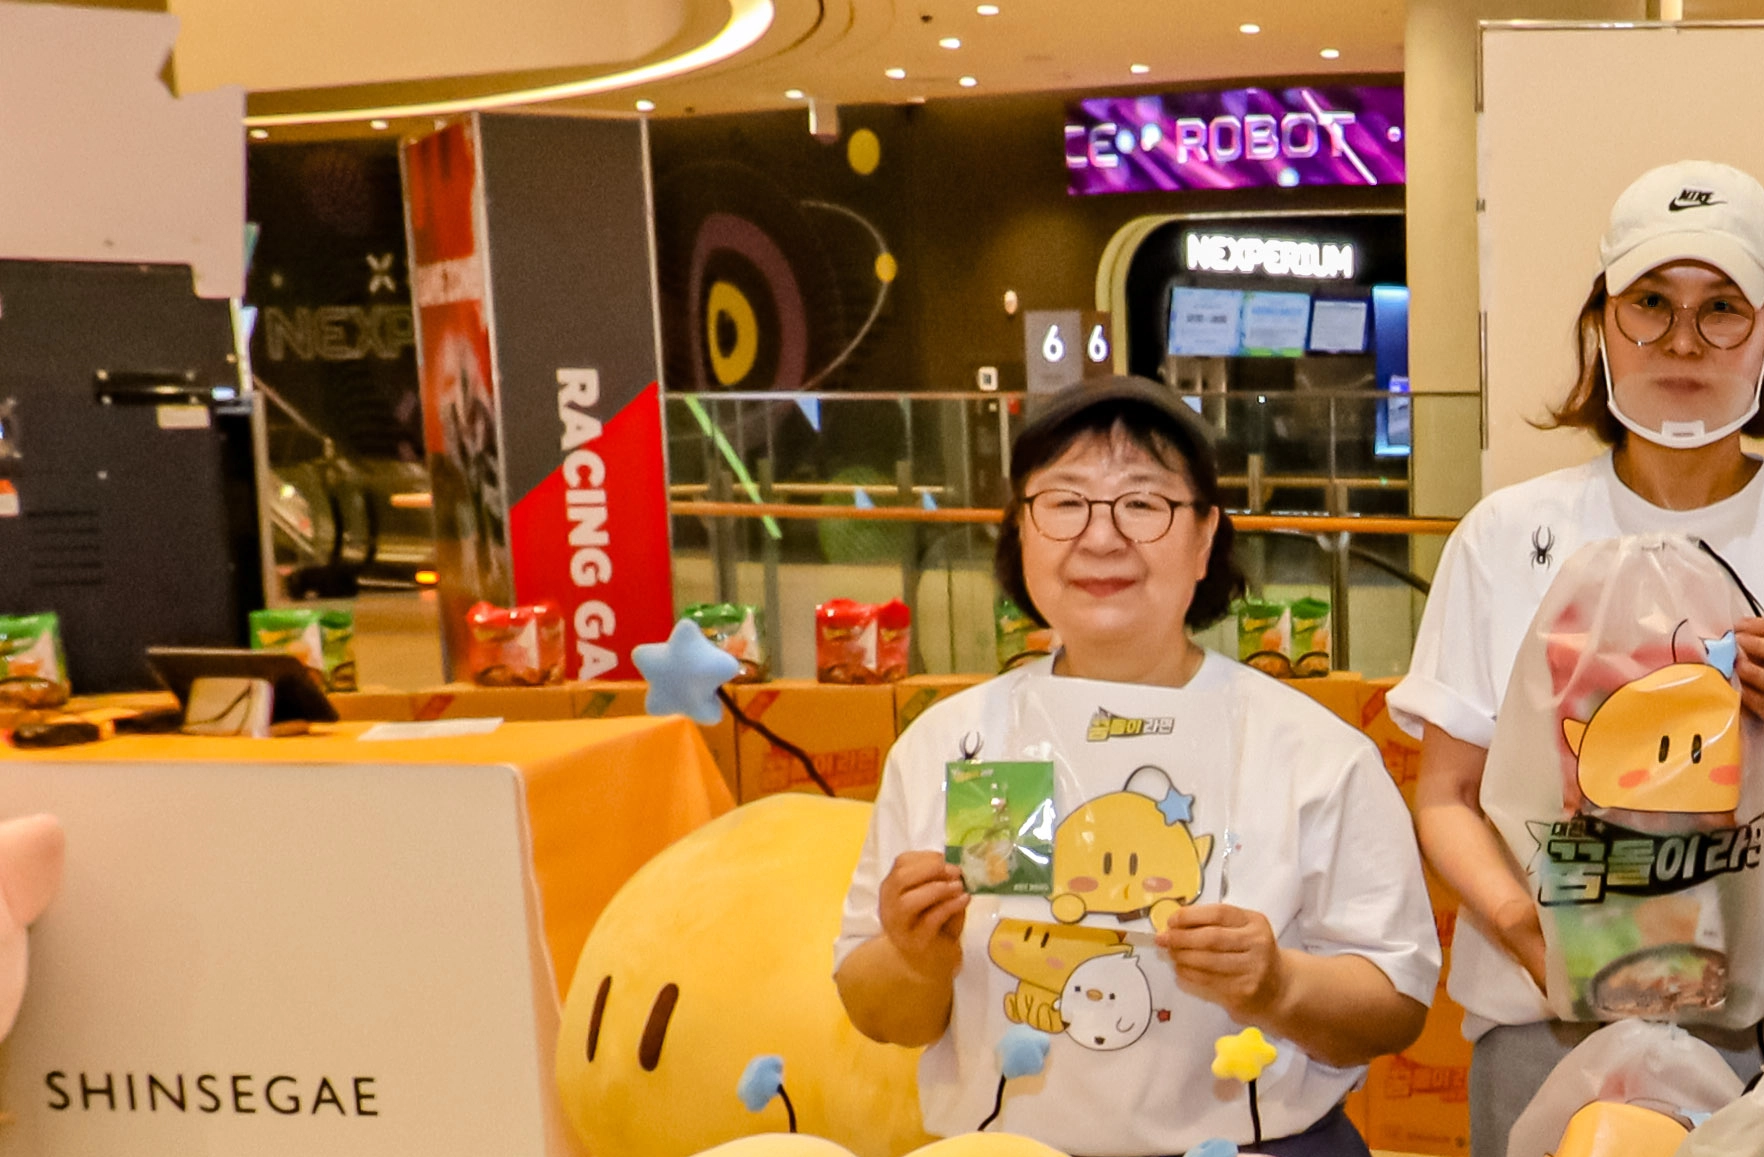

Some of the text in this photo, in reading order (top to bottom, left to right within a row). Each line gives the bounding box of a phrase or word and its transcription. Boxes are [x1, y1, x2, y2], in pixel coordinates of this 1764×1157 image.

[1176, 111, 1356, 164] ROBOT
[1186, 233, 1354, 278] NEXPERIUM
[1042, 324, 1065, 362] 6
[1087, 324, 1110, 362] 6
[556, 367, 613, 587] RACING
[45, 1071, 379, 1116] SHINSEGAE
